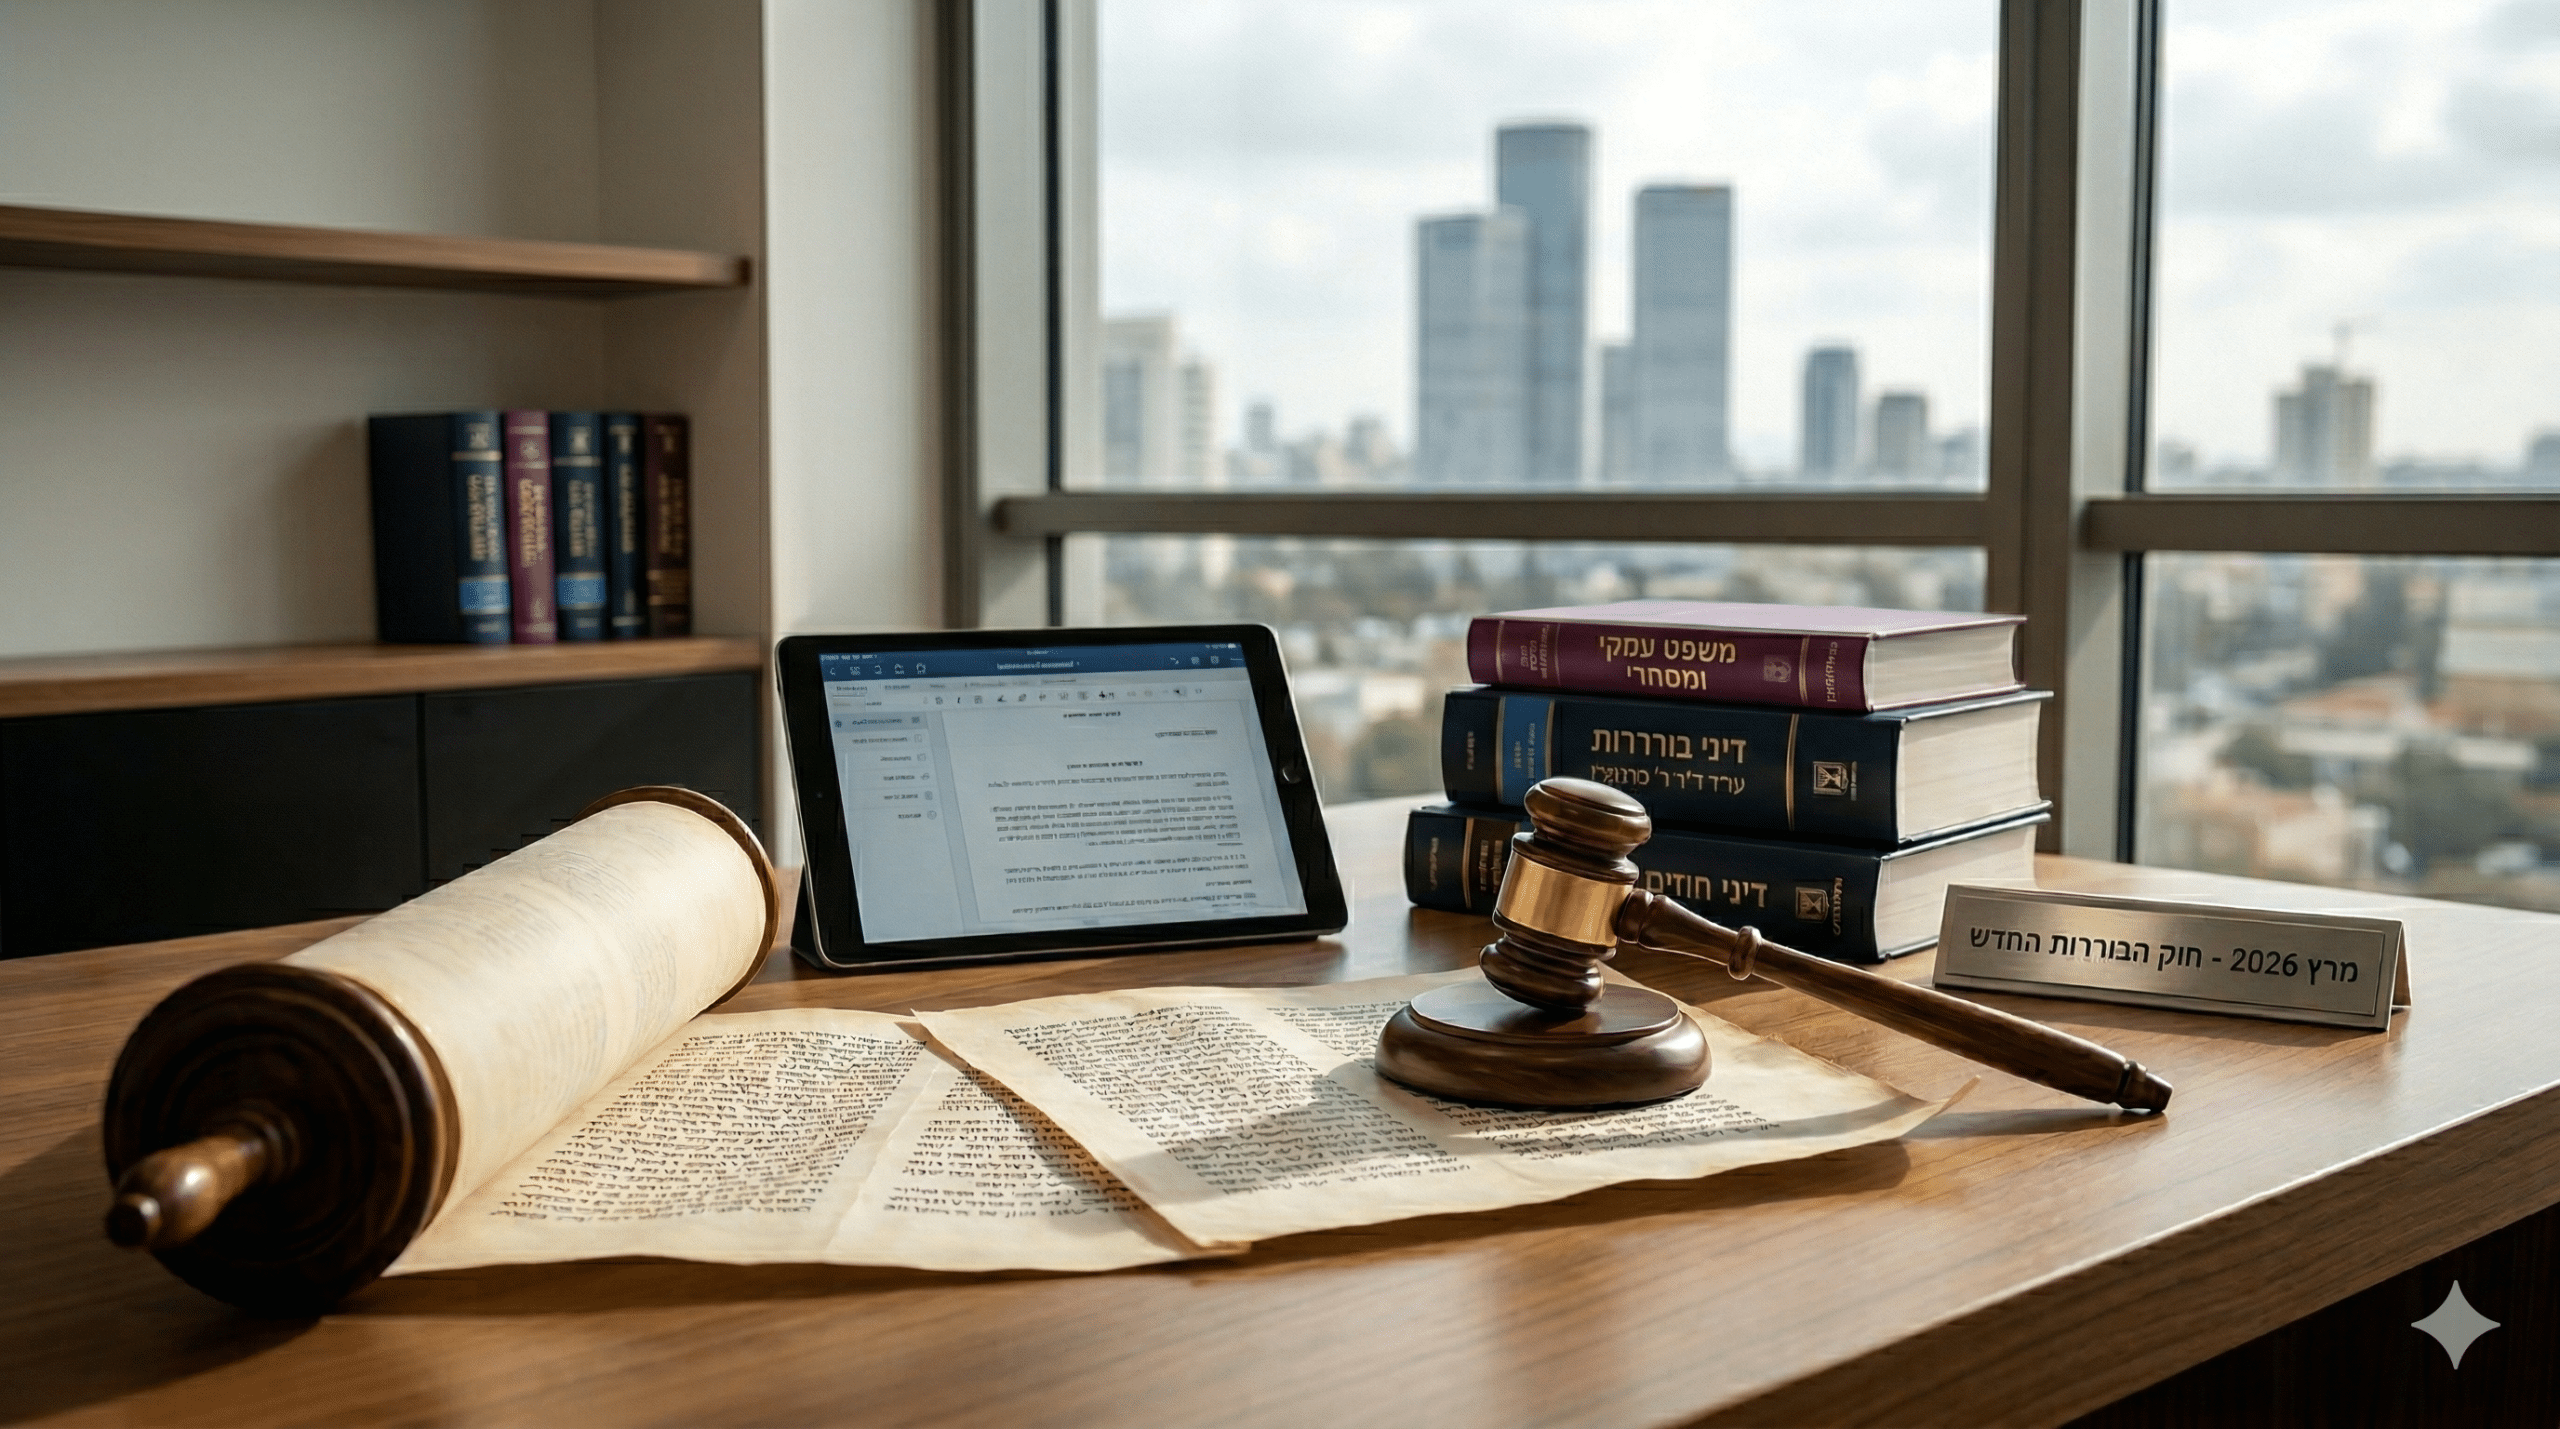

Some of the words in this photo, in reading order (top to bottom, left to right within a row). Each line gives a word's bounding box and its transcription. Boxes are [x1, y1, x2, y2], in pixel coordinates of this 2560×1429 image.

[1664, 638, 1736, 664] משפט
[1627, 665, 1707, 691] ומסחרי
[1702, 735, 1747, 764] דיני
[1643, 869, 1712, 902] חוזים
[1721, 878, 1768, 909] דיני
[1970, 926, 2042, 953] החדש
[2048, 934, 2151, 964] הבוררות
[2157, 943, 2203, 972] חוק
[2229, 946, 2300, 978] 2026
[2307, 957, 2359, 986] מרץ
